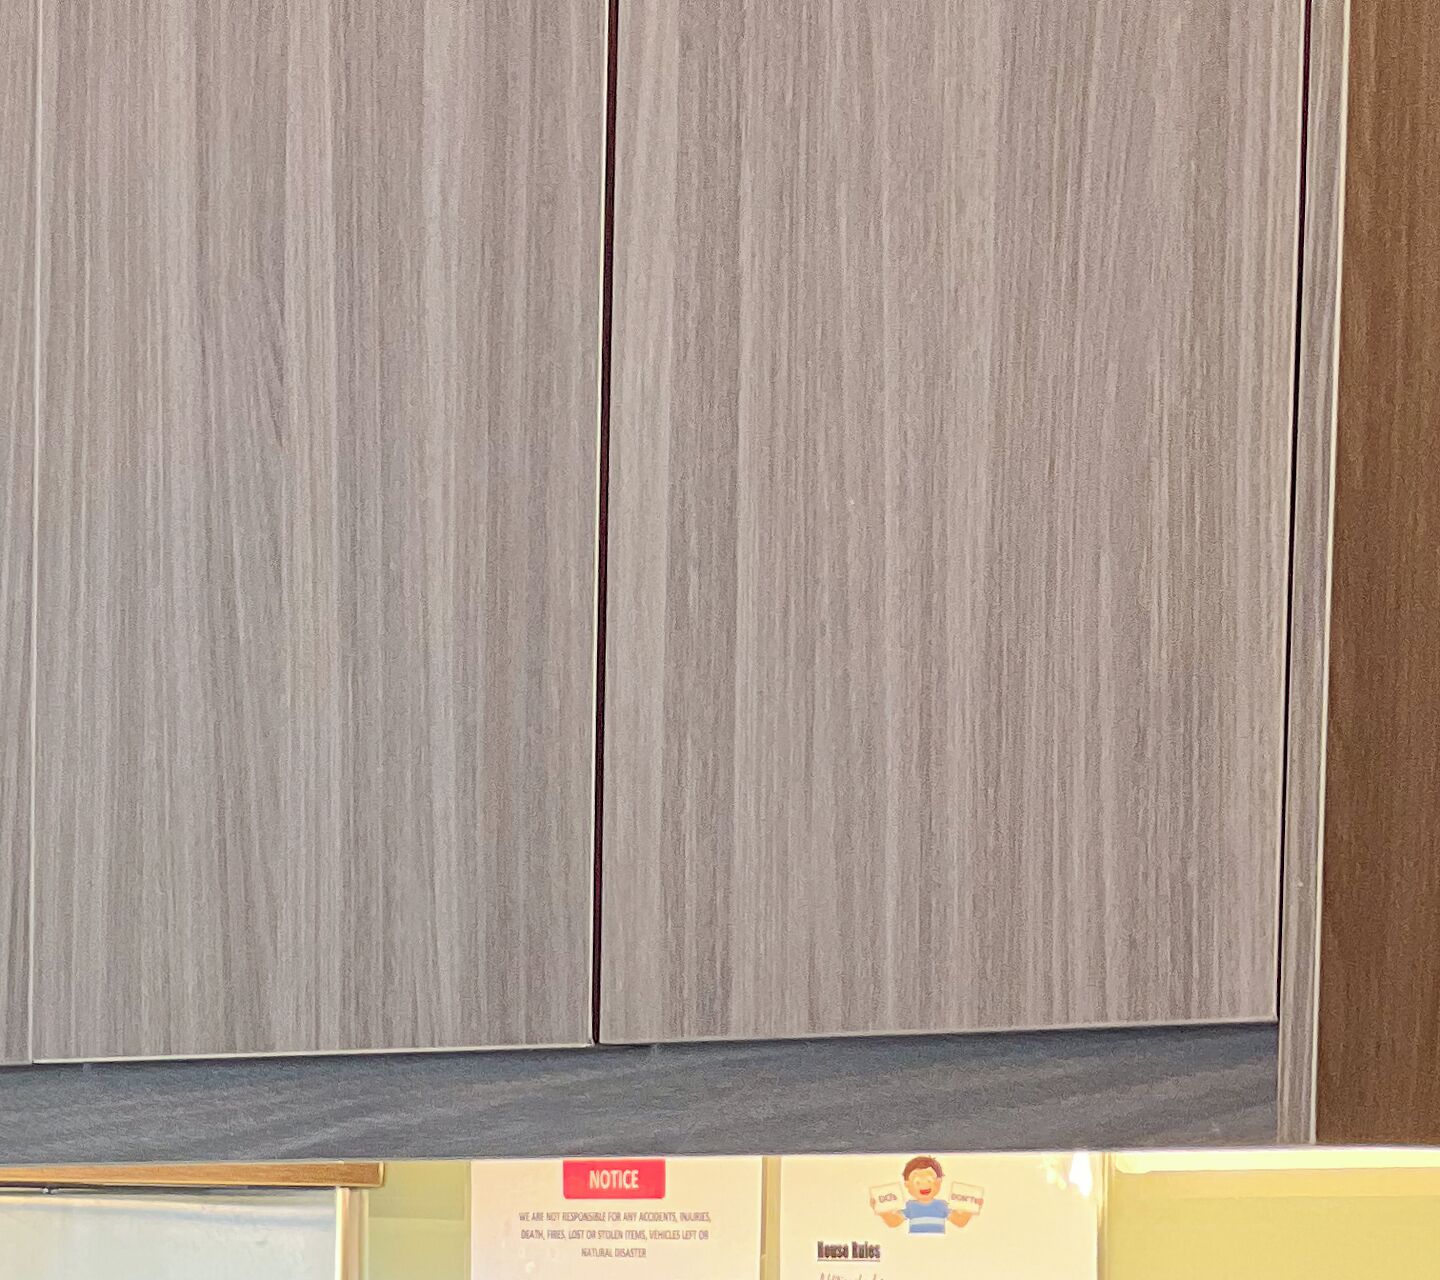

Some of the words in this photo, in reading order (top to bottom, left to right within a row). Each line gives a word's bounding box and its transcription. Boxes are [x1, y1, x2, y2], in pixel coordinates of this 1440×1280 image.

[589, 1169, 639, 1190] NOTICE
[519, 1211, 529, 1222] WE
[531, 1211, 544, 1222] ARE
[546, 1211, 560, 1222] NOT
[562, 1211, 606, 1222] RESPONSIBLE
[608, 1211, 621, 1222] FOR
[623, 1211, 637, 1222] ANY
[569, 1229, 584, 1240] LOST
[586, 1229, 596, 1240] OR
[598, 1229, 623, 1240] STOLEN
[649, 1229, 680, 1240] VEHICLES
[682, 1229, 697, 1240] LEFT
[699, 1229, 709, 1240] OR
[581, 1247, 613, 1258] NATURAL
[615, 1247, 647, 1258] DISASTER
[817, 1240, 849, 1259] House
[851, 1240, 881, 1259] Rules
